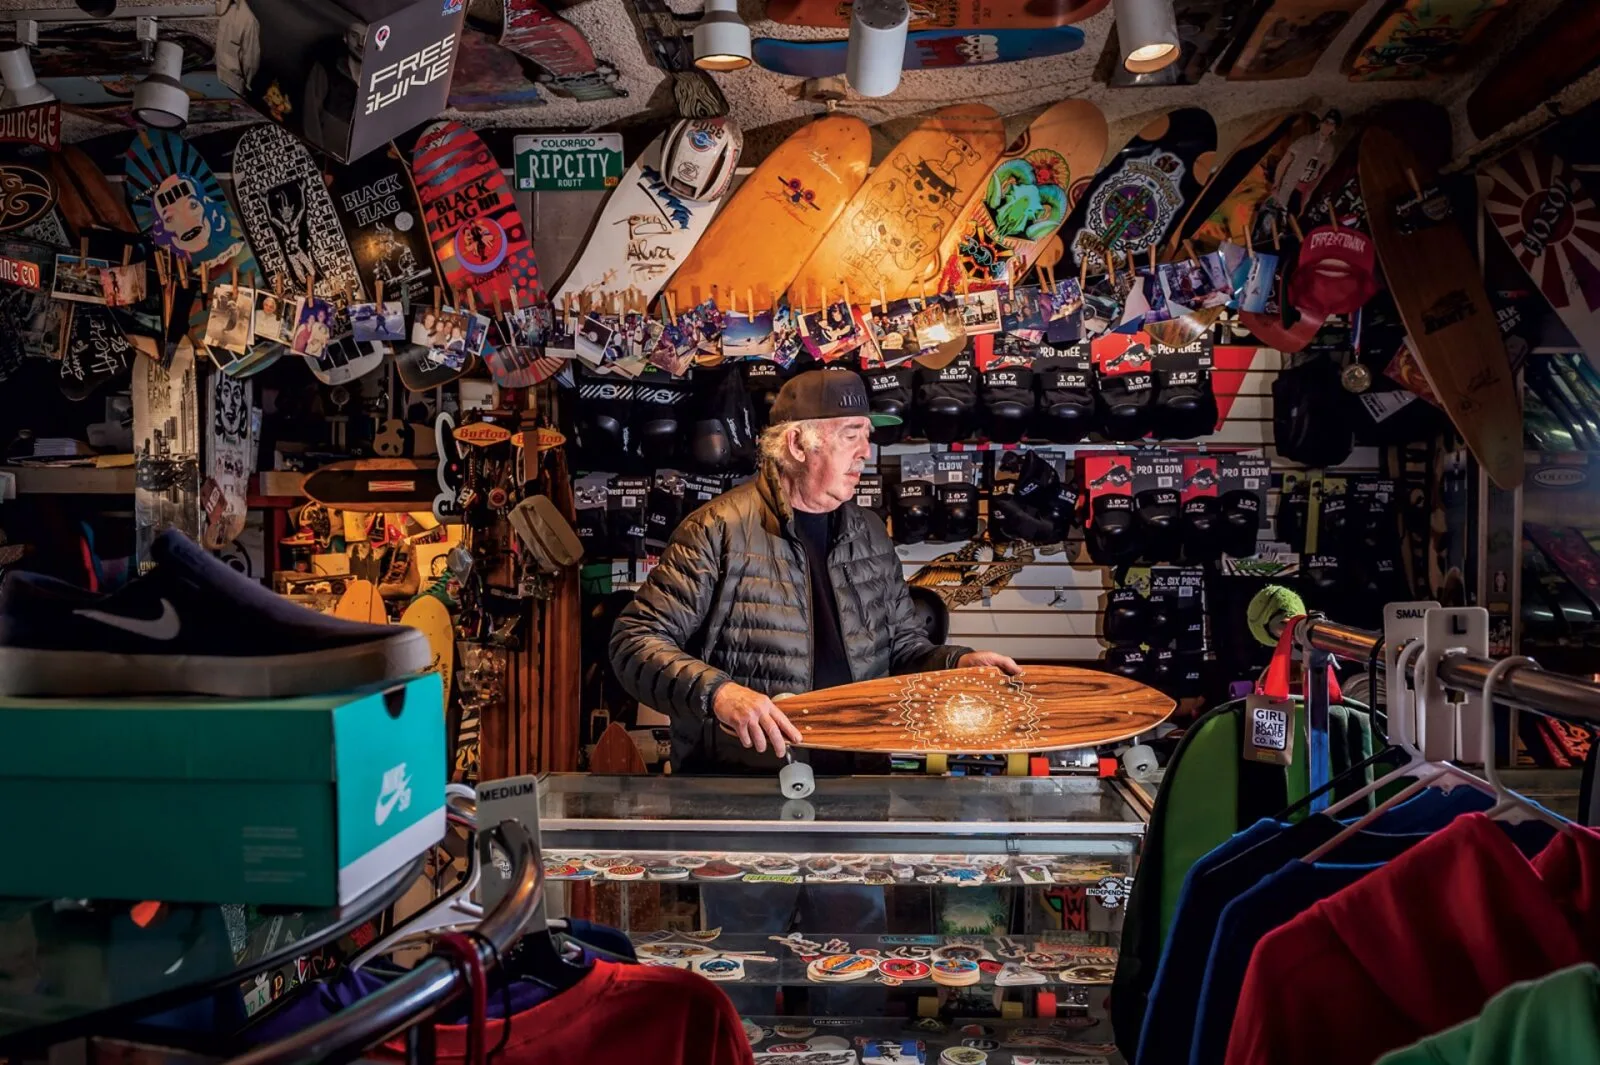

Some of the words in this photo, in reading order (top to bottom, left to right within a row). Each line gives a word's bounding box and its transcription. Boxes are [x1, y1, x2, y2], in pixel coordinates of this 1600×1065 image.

[541, 138, 595, 148] COLORADO
[529, 153, 609, 179] RIPCITY
[558, 179, 582, 187] ROUTT
[342, 173, 403, 212] BLACK
[433, 177, 491, 215] BLACK
[355, 195, 400, 227] FLAG
[436, 202, 477, 232] FLAG
[943, 368, 966, 376] 187
[991, 373, 1016, 381] 187
[1171, 372, 1196, 380] 187
[873, 375, 897, 384] 187
[1128, 376, 1150, 385] 187
[459, 428, 507, 439] Burton
[517, 433, 562, 444] Bton
[938, 461, 963, 471] ELBOW
[1137, 465, 1152, 475] PRO
[1155, 464, 1182, 474] ELBOW
[1222, 468, 1238, 477] PRO
[1242, 467, 1269, 476] ELBOW
[1167, 577, 1180, 585] SIX
[1181, 577, 1201, 586] PACK
[1452, 615, 1467, 635] L
[1256, 710, 1285, 723] GIRL
[1255, 721, 1285, 732] SKATE
[1255, 729, 1284, 738] BOARD
[480, 783, 533, 800] MEDIUM
[1088, 888, 1125, 896] INDEPEND
